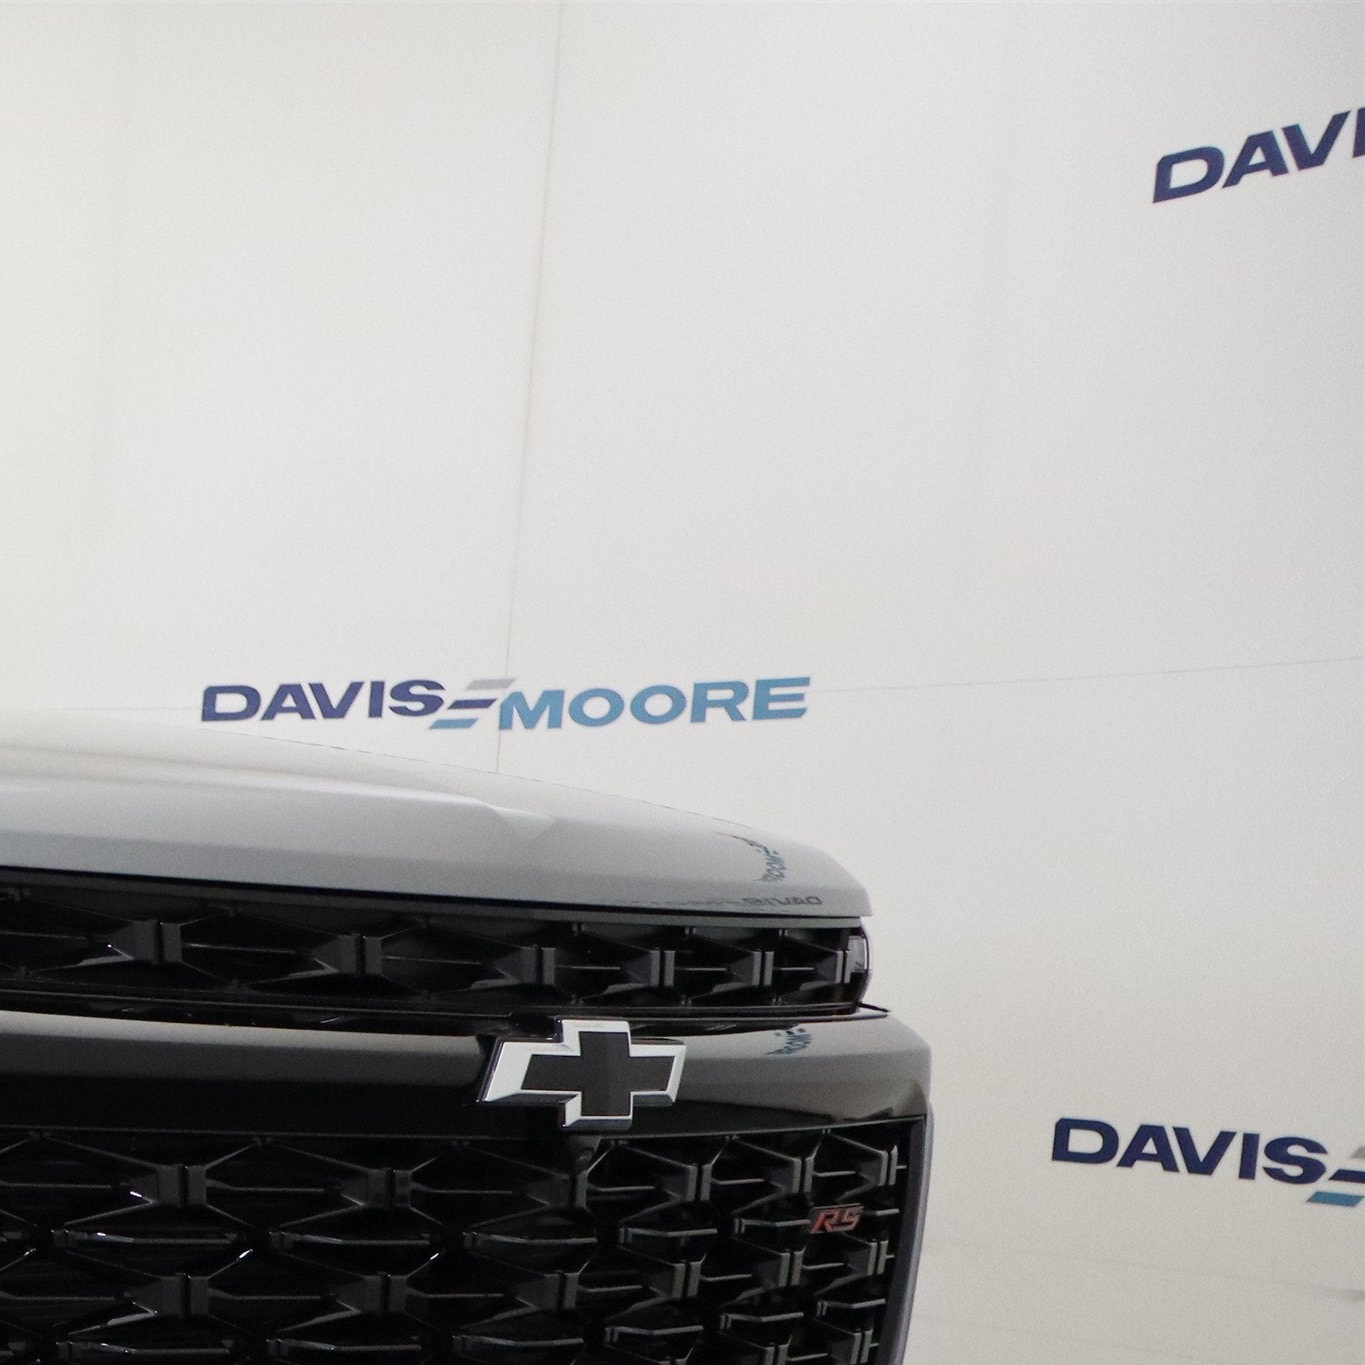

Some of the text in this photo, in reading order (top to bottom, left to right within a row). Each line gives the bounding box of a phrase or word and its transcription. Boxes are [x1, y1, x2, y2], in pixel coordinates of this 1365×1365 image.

[1152, 106, 1365, 204] DAVI
[200, 676, 811, 731] DAVIS MOORE
[1051, 1117, 1329, 1186] DAVIS
[809, 1203, 863, 1235] RS
